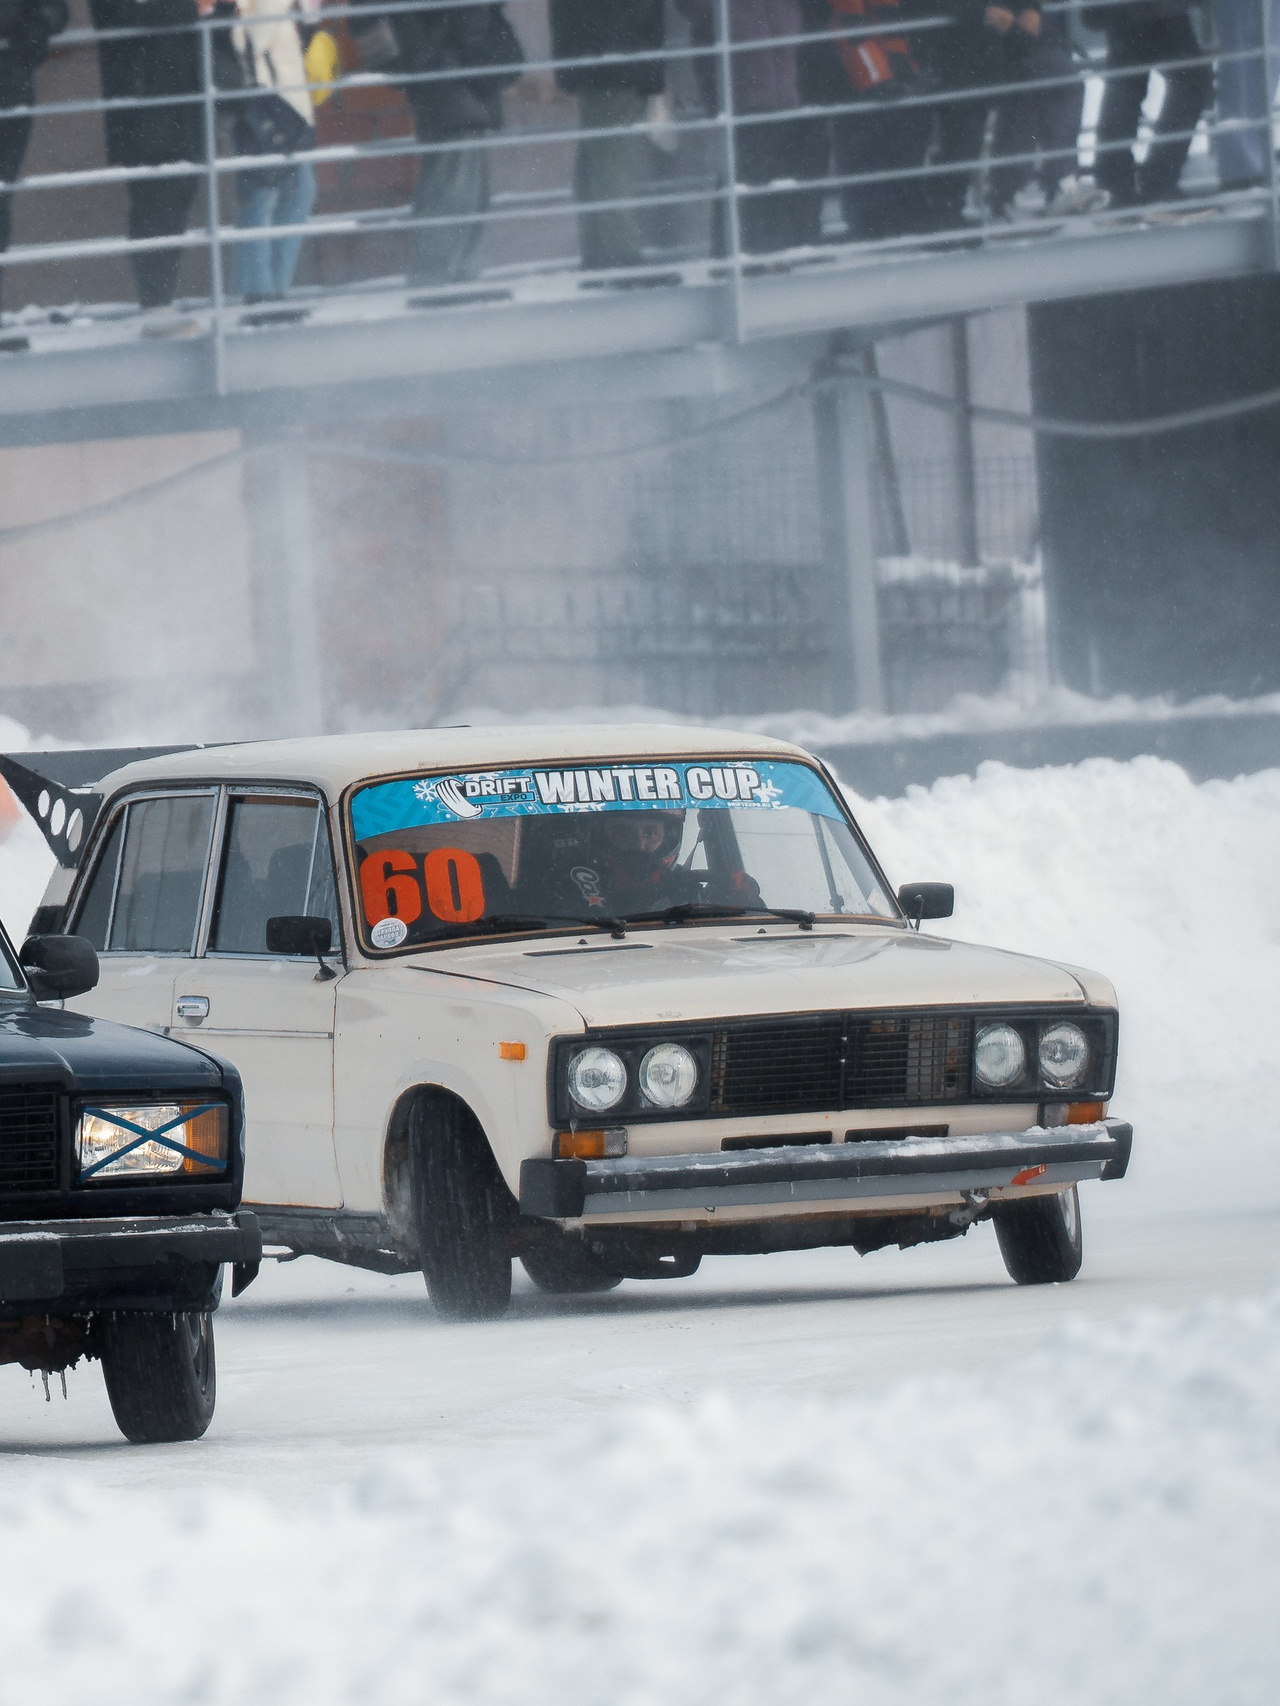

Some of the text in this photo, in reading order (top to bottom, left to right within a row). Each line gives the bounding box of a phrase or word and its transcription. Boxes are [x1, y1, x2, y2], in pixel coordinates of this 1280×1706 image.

[465, 777, 530, 797] DRIFT
[501, 793, 527, 801] EXPO
[535, 767, 760, 804] WINTER CUP
[360, 847, 486, 927] 60
